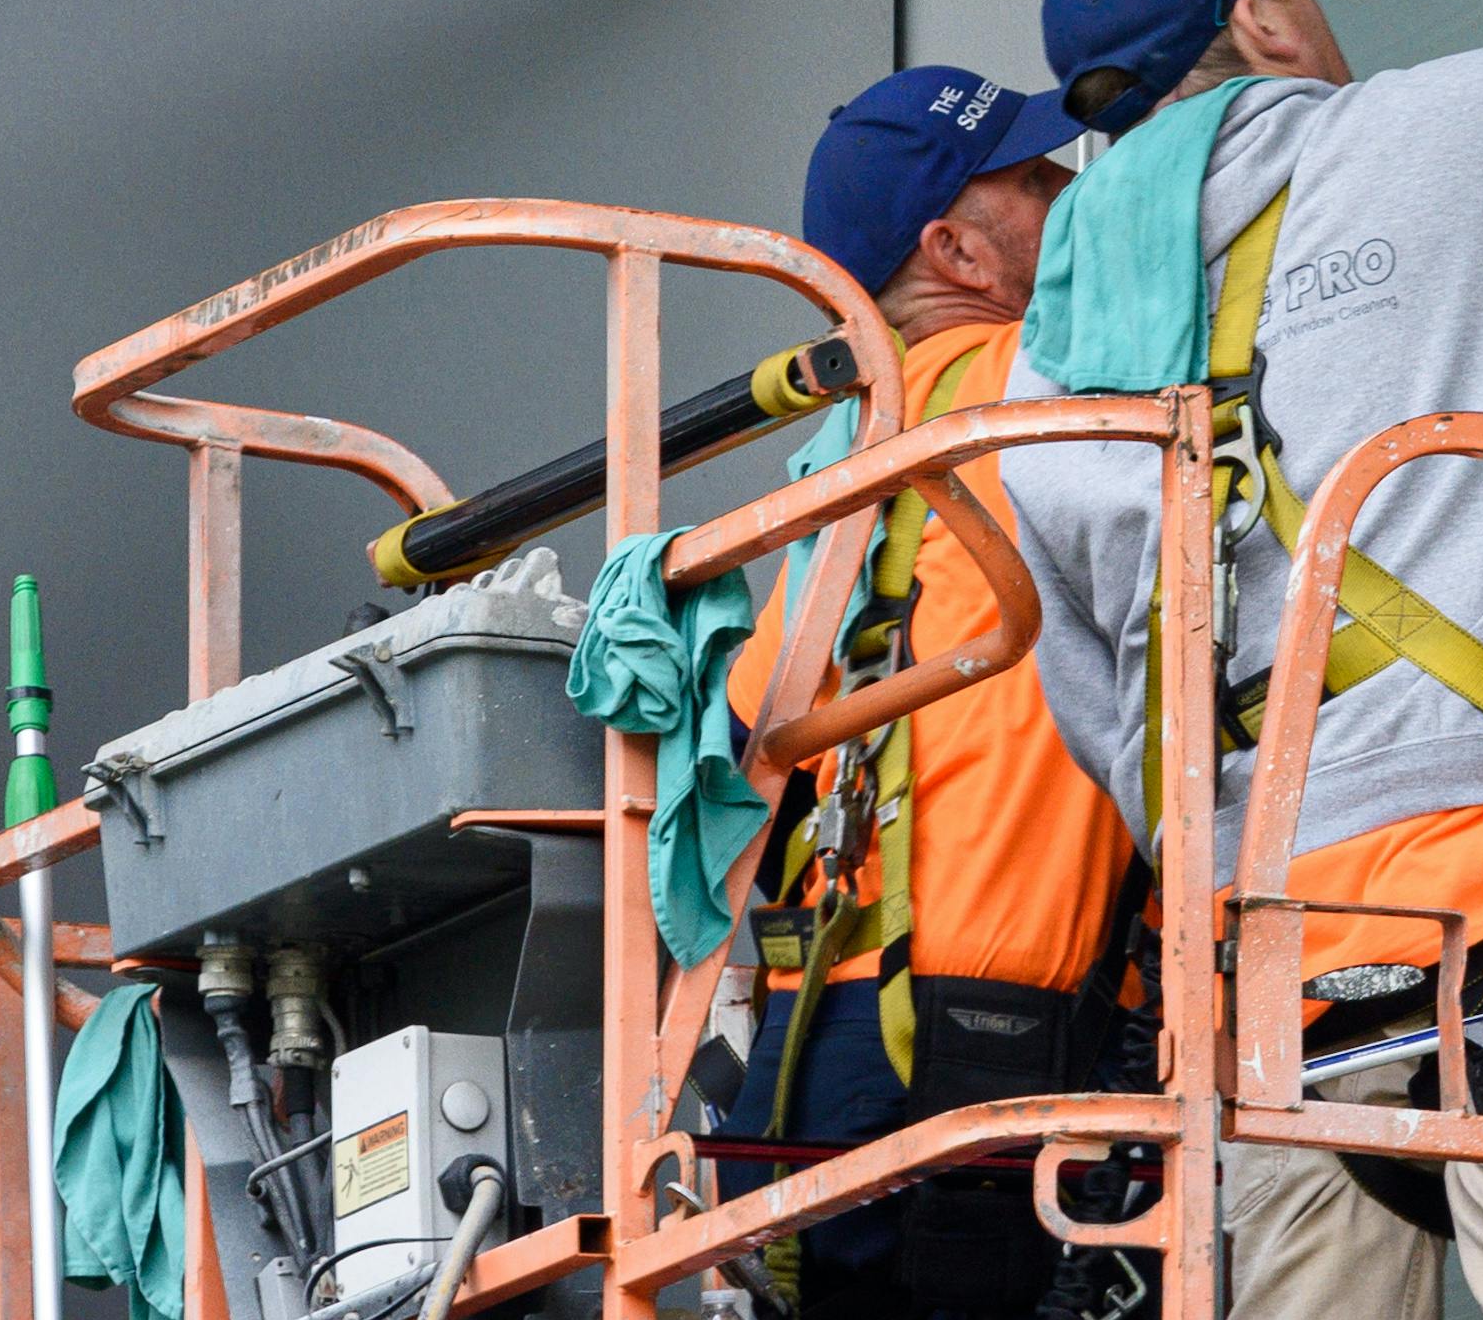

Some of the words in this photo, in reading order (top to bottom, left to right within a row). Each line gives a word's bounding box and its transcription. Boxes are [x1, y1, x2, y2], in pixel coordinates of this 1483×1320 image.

[928, 85, 964, 115] THE
[1285, 238, 1396, 313] PRO
[1284, 314, 1335, 339] Window
[1338, 296, 1399, 321] Cleaning
